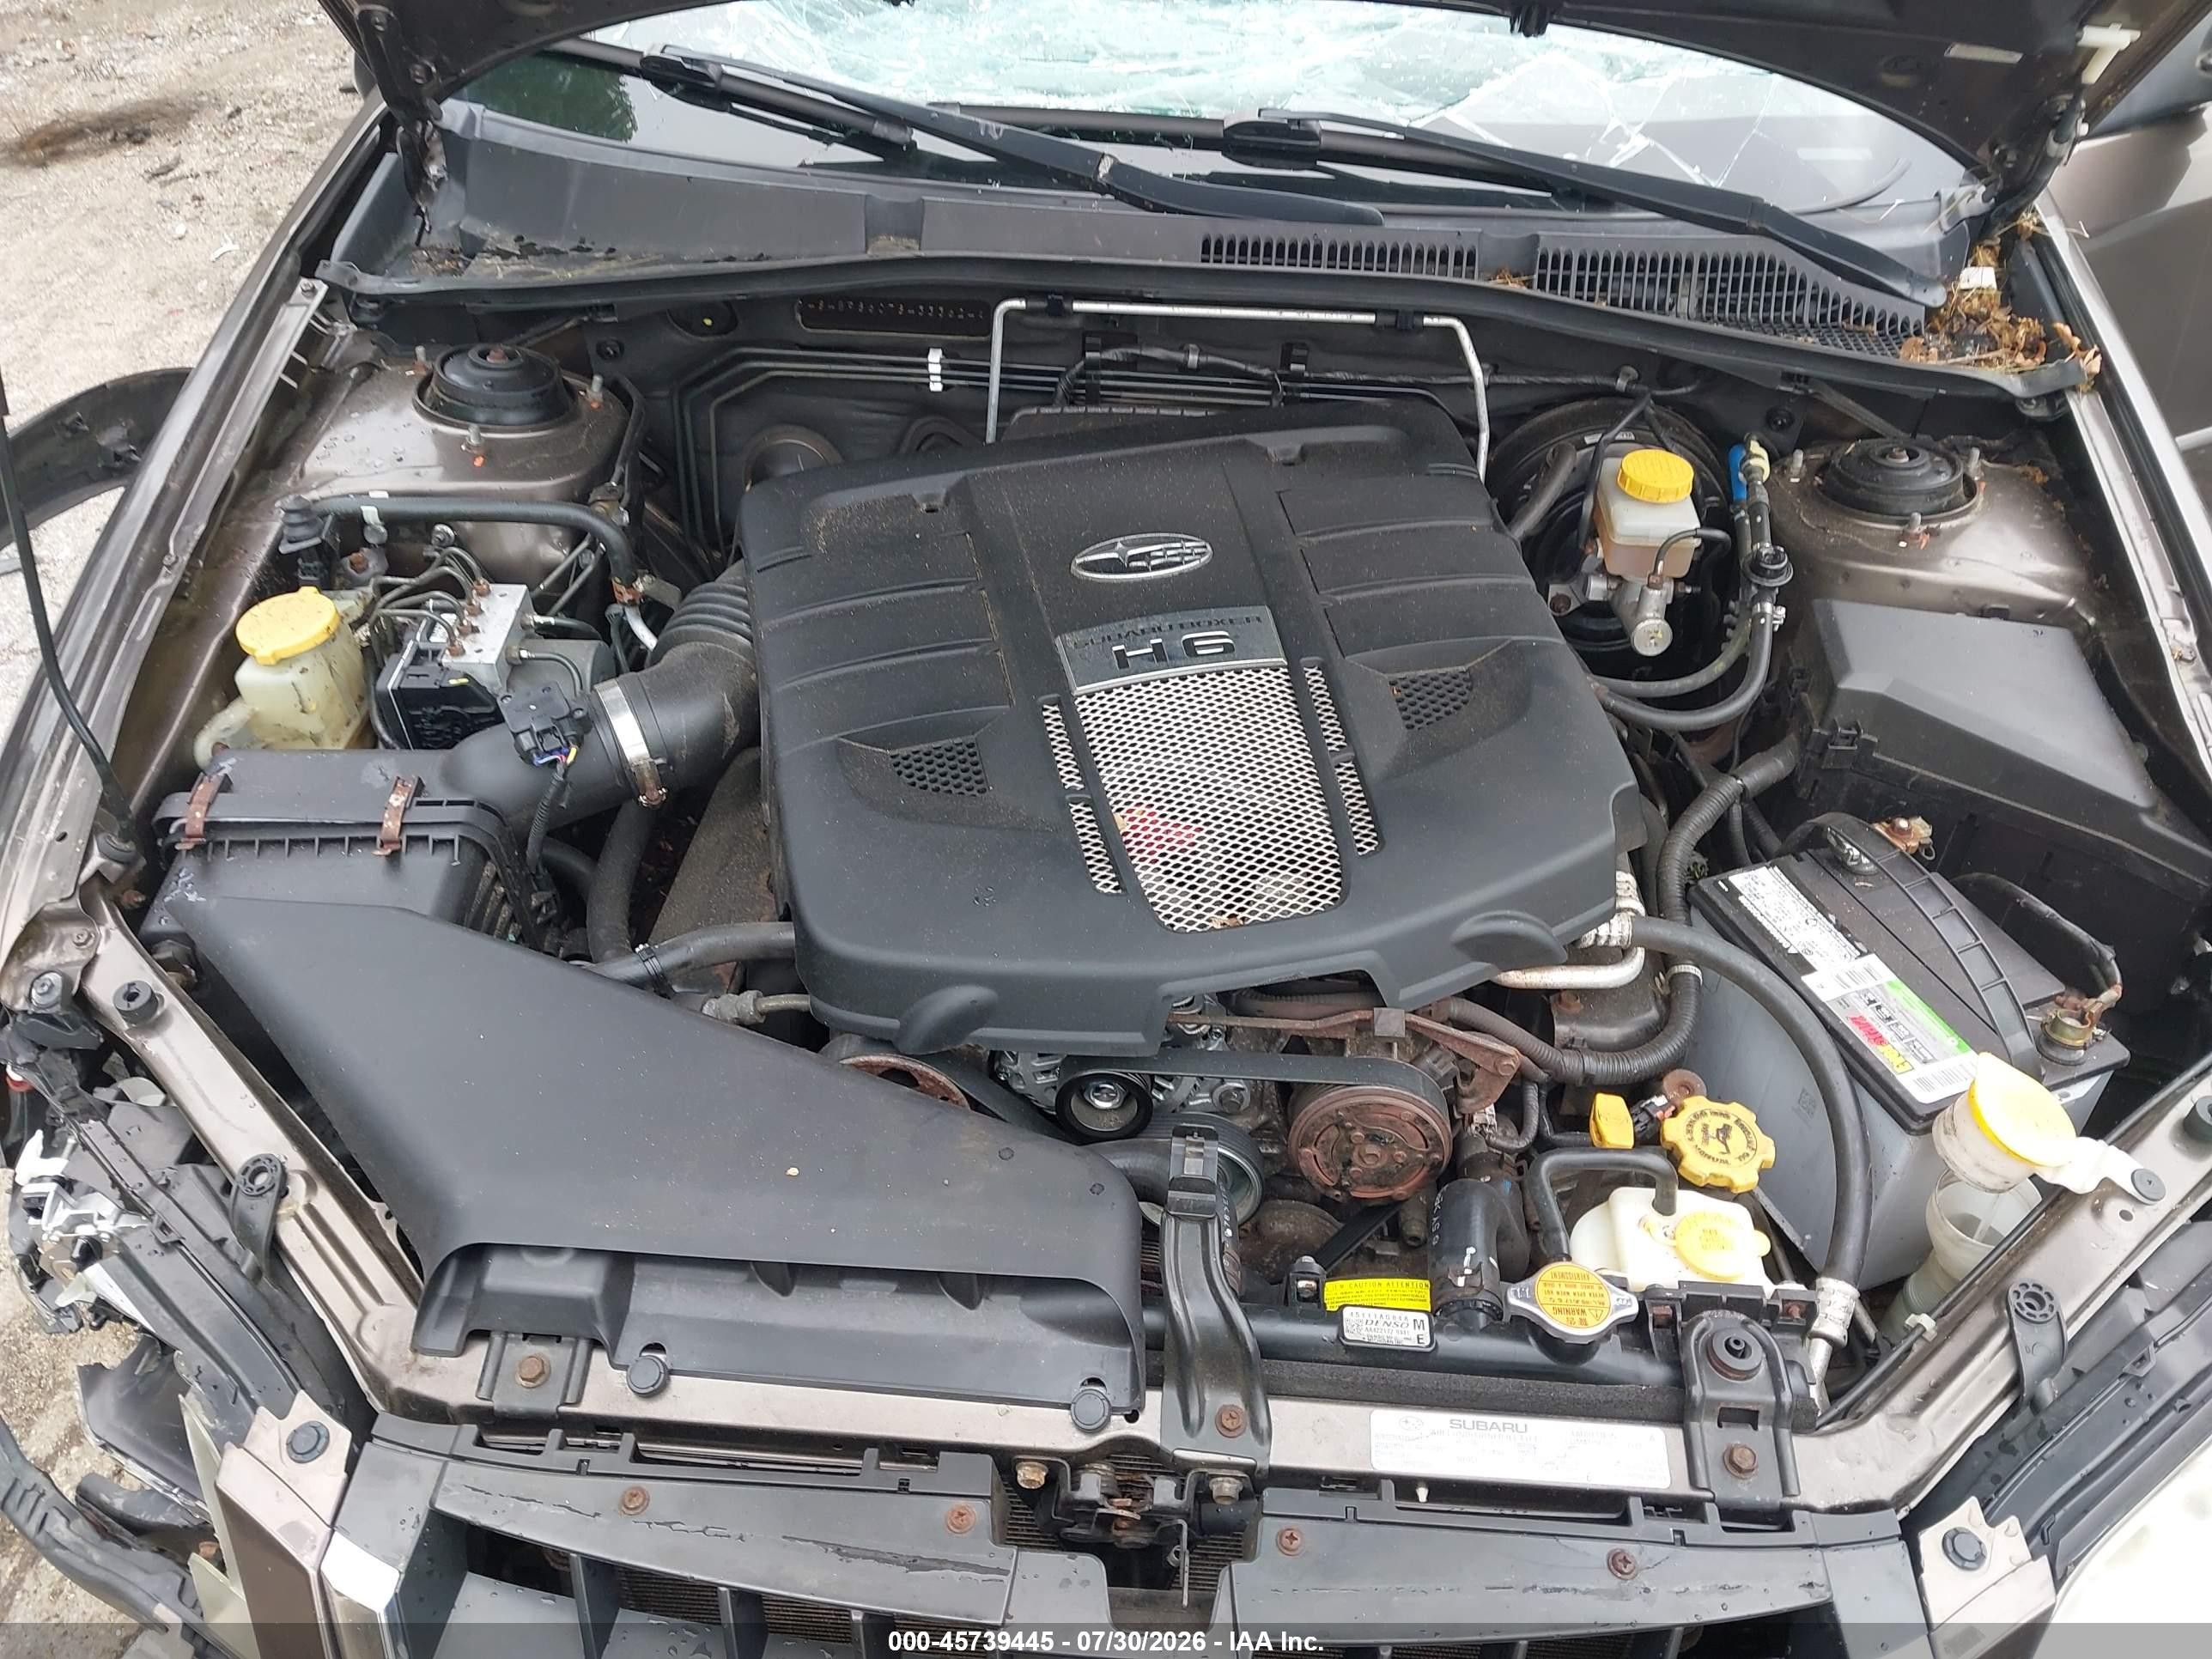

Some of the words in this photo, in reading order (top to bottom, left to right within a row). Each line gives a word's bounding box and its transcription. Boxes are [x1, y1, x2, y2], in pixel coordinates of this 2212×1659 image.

[1386, 1280, 1431, 1289] ATTENTION
[1553, 1306, 1588, 1316] WARNING
[1364, 1319, 1410, 1329] DENSO
[1413, 1318, 1425, 1331] M
[1417, 1334, 1425, 1345] E
[1449, 1419, 1528, 1434] SUBARU
